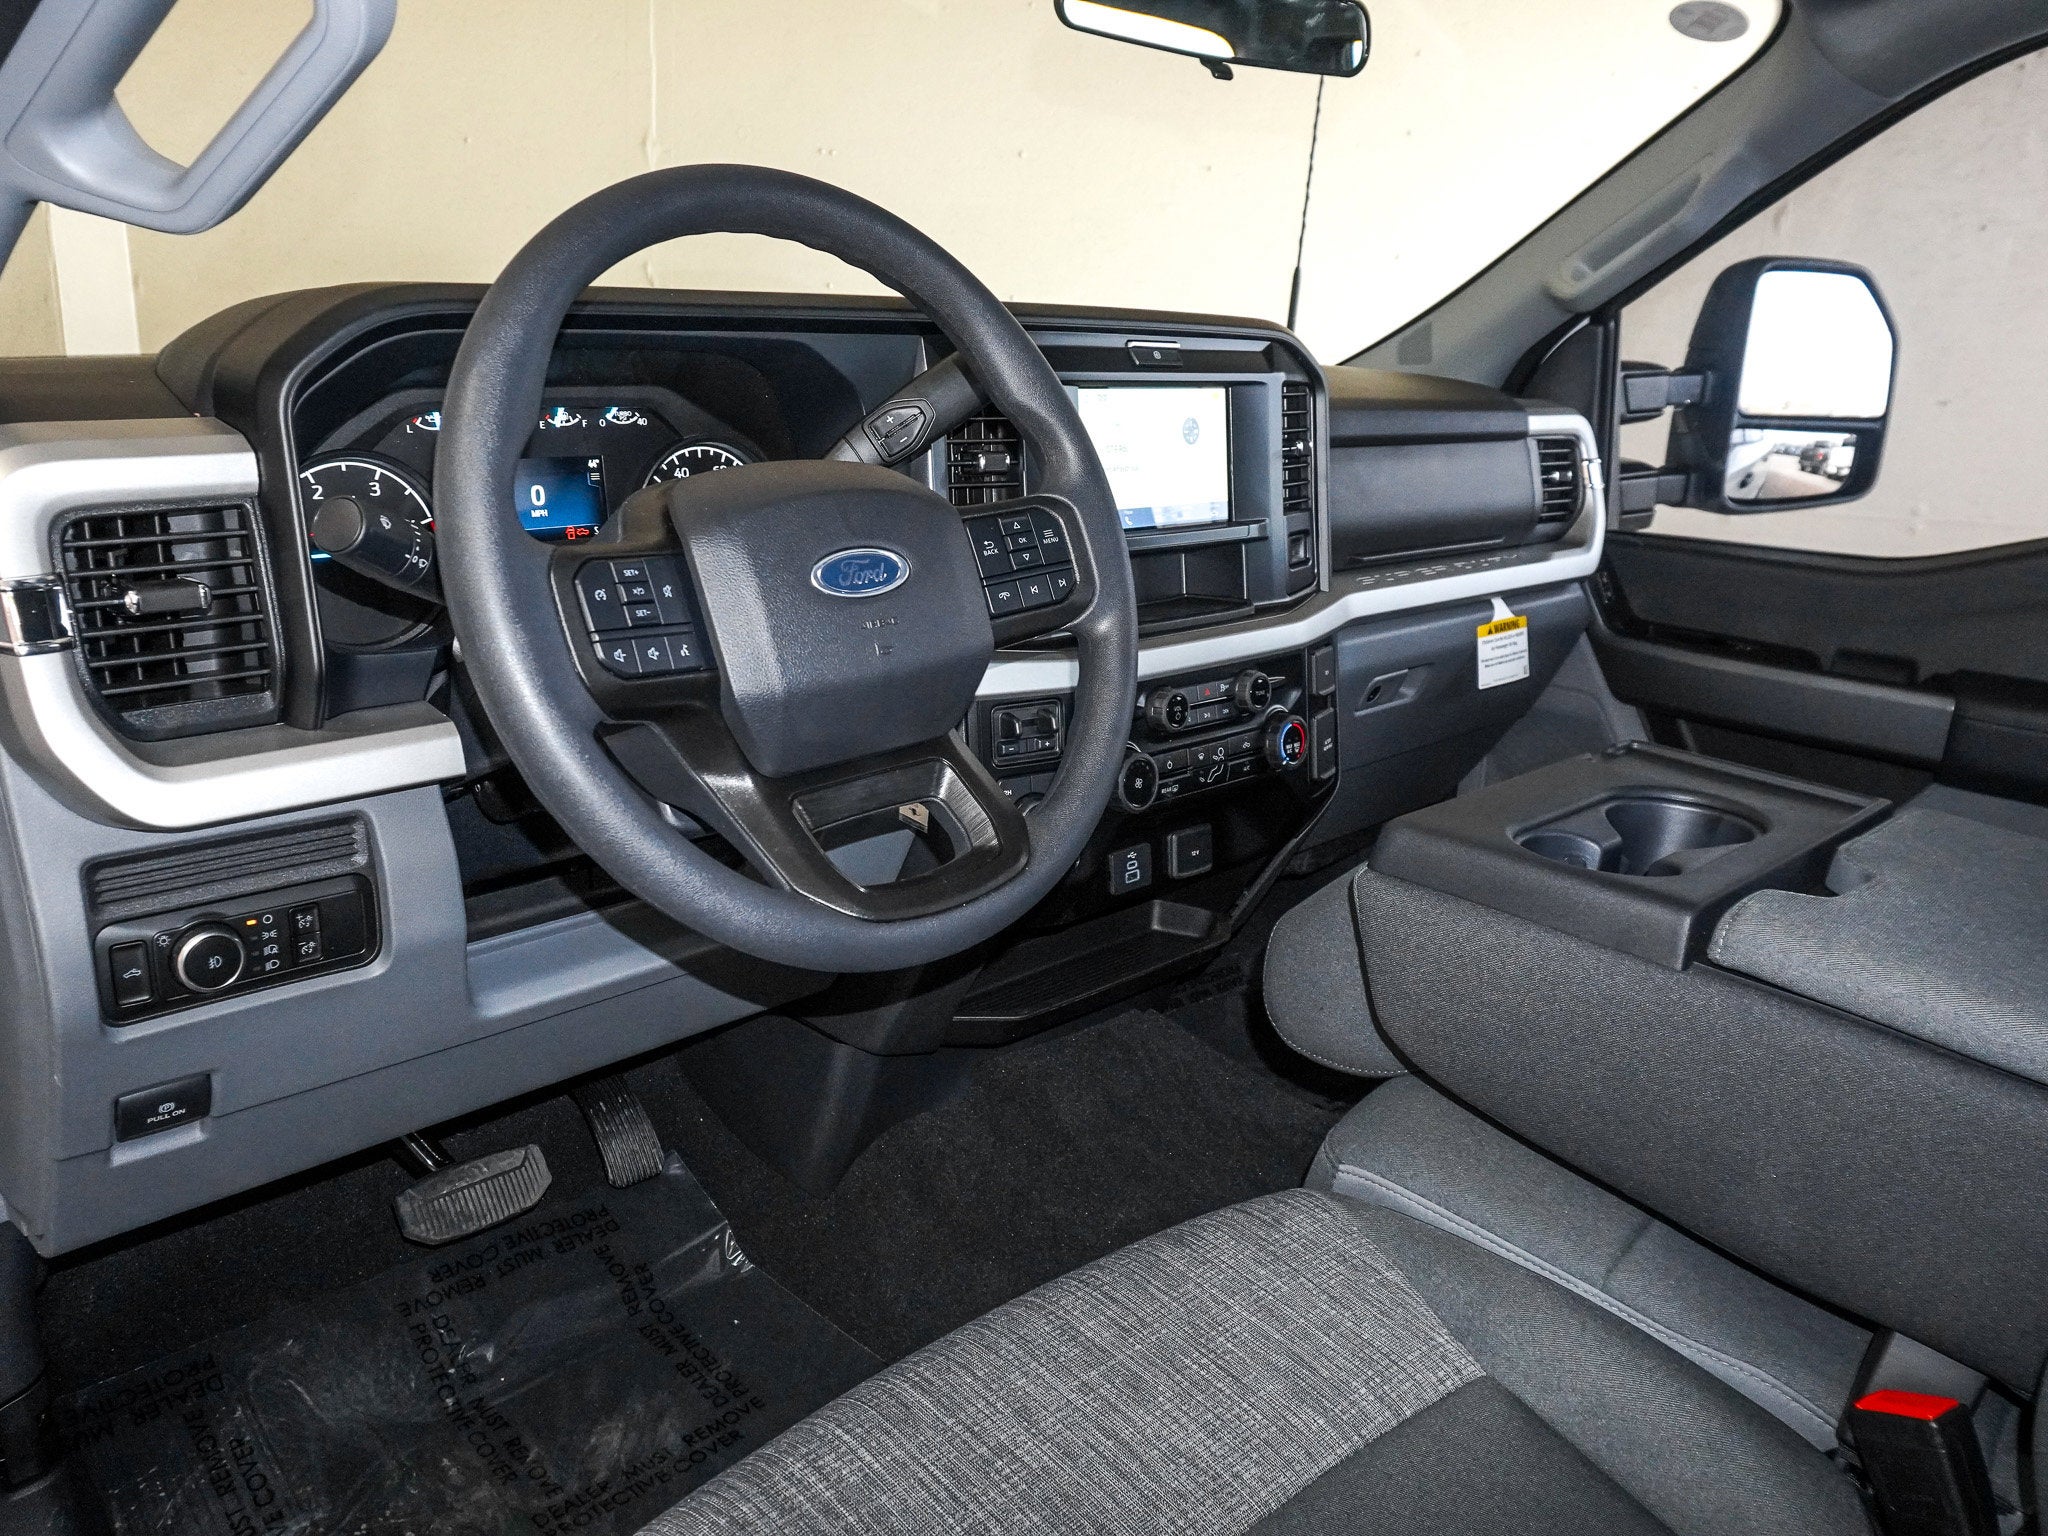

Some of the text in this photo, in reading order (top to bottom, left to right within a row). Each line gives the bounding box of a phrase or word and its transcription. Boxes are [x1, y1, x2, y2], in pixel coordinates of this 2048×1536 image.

[637, 417, 648, 426] 40
[674, 467, 690, 478] 40
[311, 485, 324, 500] 2
[369, 482, 381, 497] 3
[530, 485, 546, 507] 0
[531, 509, 548, 519] MPH
[983, 548, 999, 557] BACK
[1042, 537, 1059, 545] MENU
[839, 559, 888, 587] Ford
[1494, 619, 1520, 633] WARNING
[147, 1108, 186, 1123] PULL ON
[428, 1203, 610, 1283] PROTECTIVE COVER
[496, 1246, 544, 1280] MUST
[395, 1274, 487, 1318] REMOVE
[594, 1244, 730, 1408] DEALER MUST REMOVE
[634, 1262, 749, 1398] PROTECTIVE COVER
[467, 1430, 519, 1486] COVER
[531, 1397, 767, 1530] DEALER MUST REMOVE
[673, 1429, 746, 1474] COVER
[229, 1438, 277, 1509] COVER
